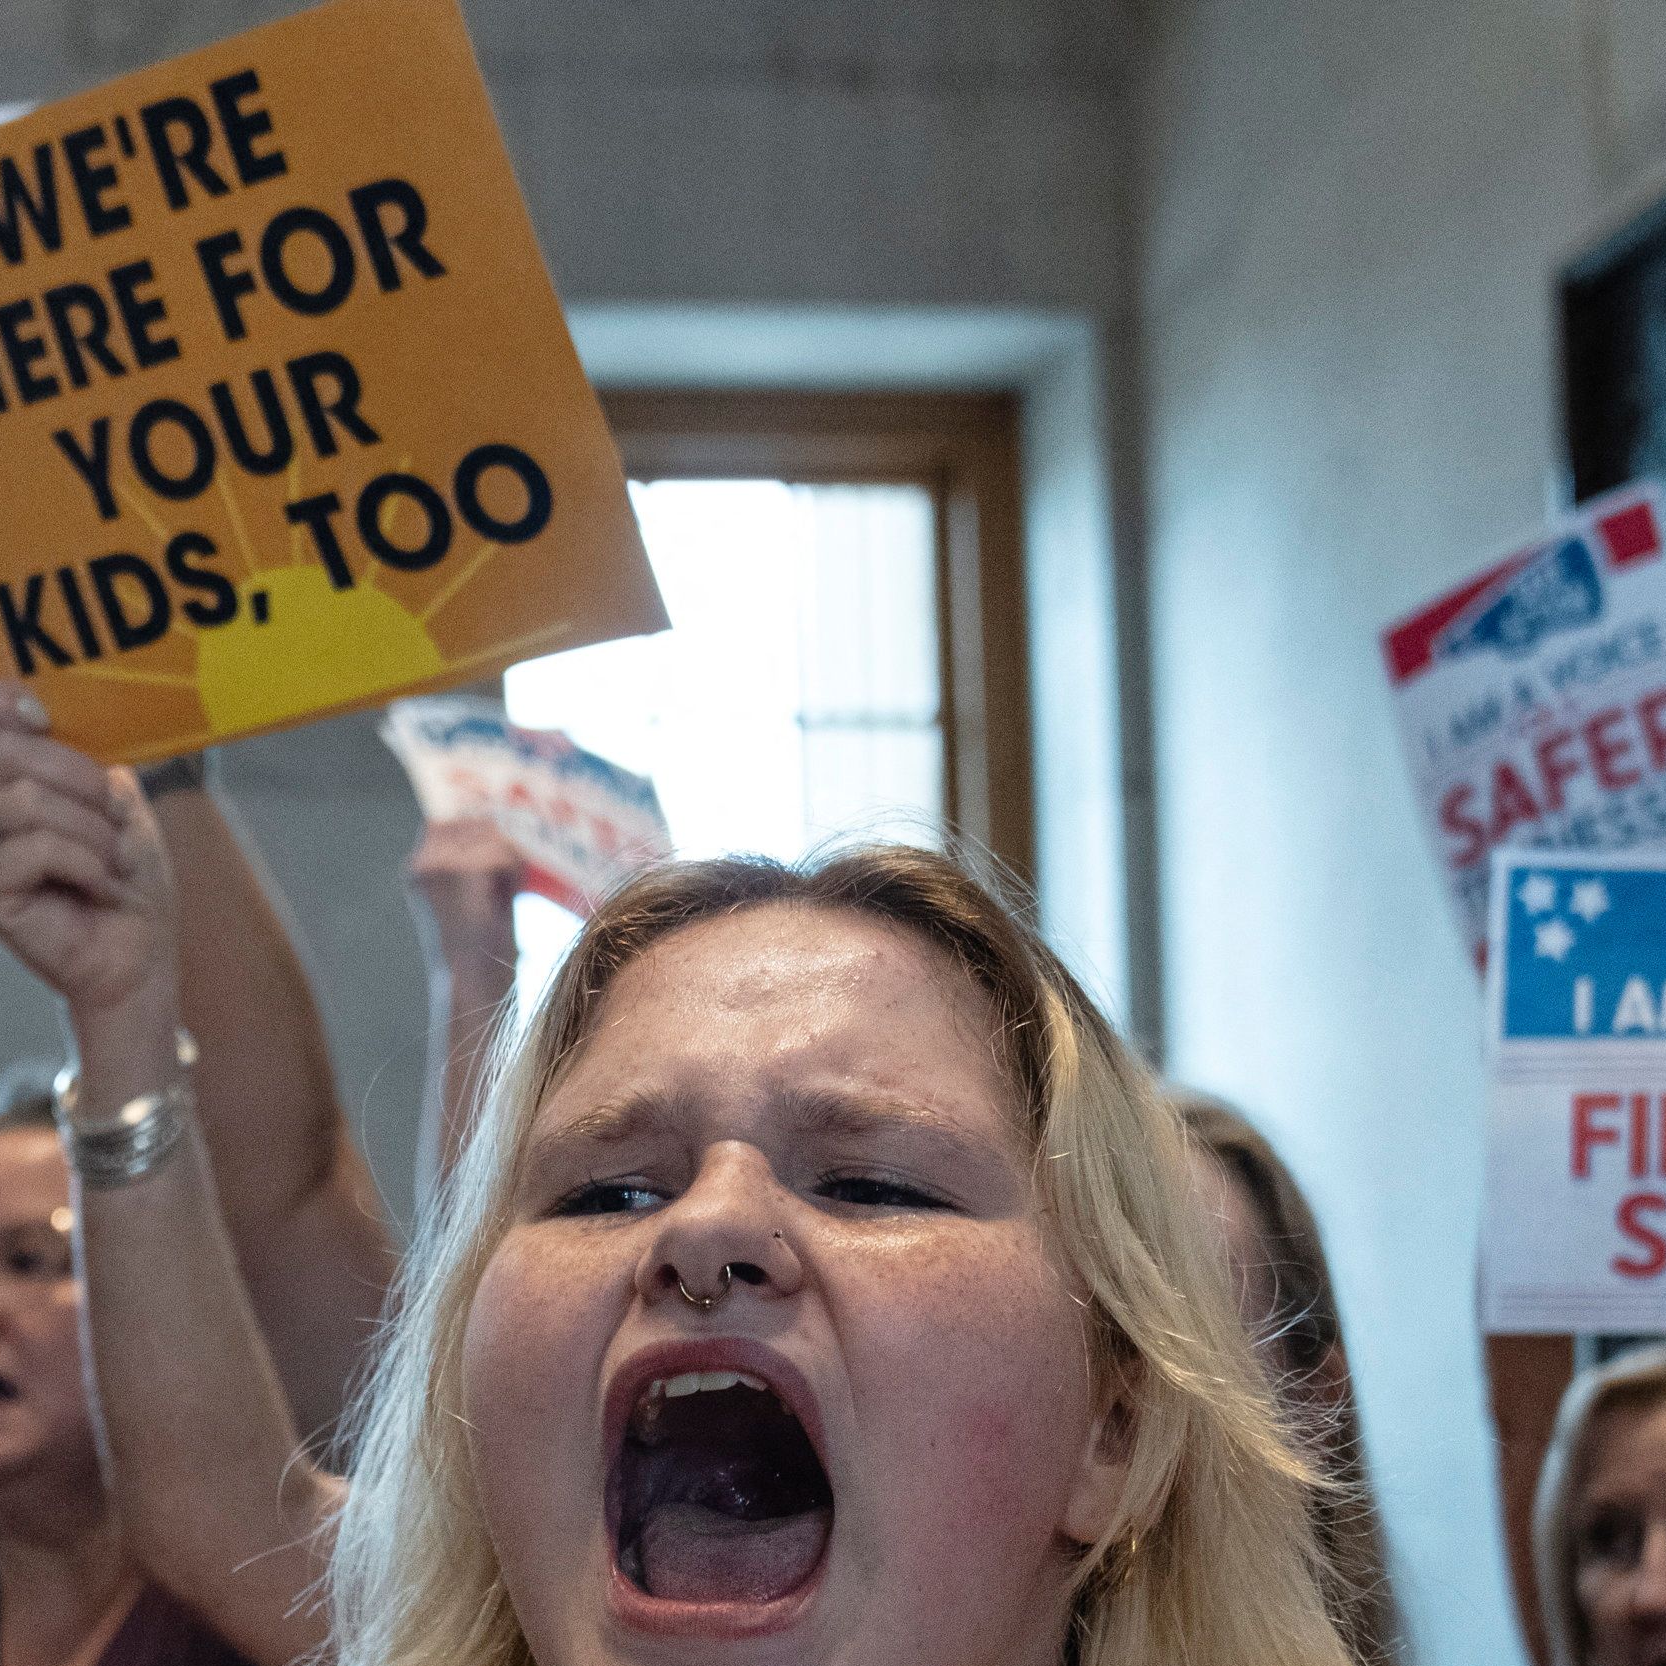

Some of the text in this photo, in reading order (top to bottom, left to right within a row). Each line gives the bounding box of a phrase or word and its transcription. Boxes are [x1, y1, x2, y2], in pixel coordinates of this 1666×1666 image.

[196, 176, 448, 344] FOR
[54, 350, 382, 522] YOUR
[285, 442, 554, 592] TOO
[1573, 976, 1595, 1034] I
